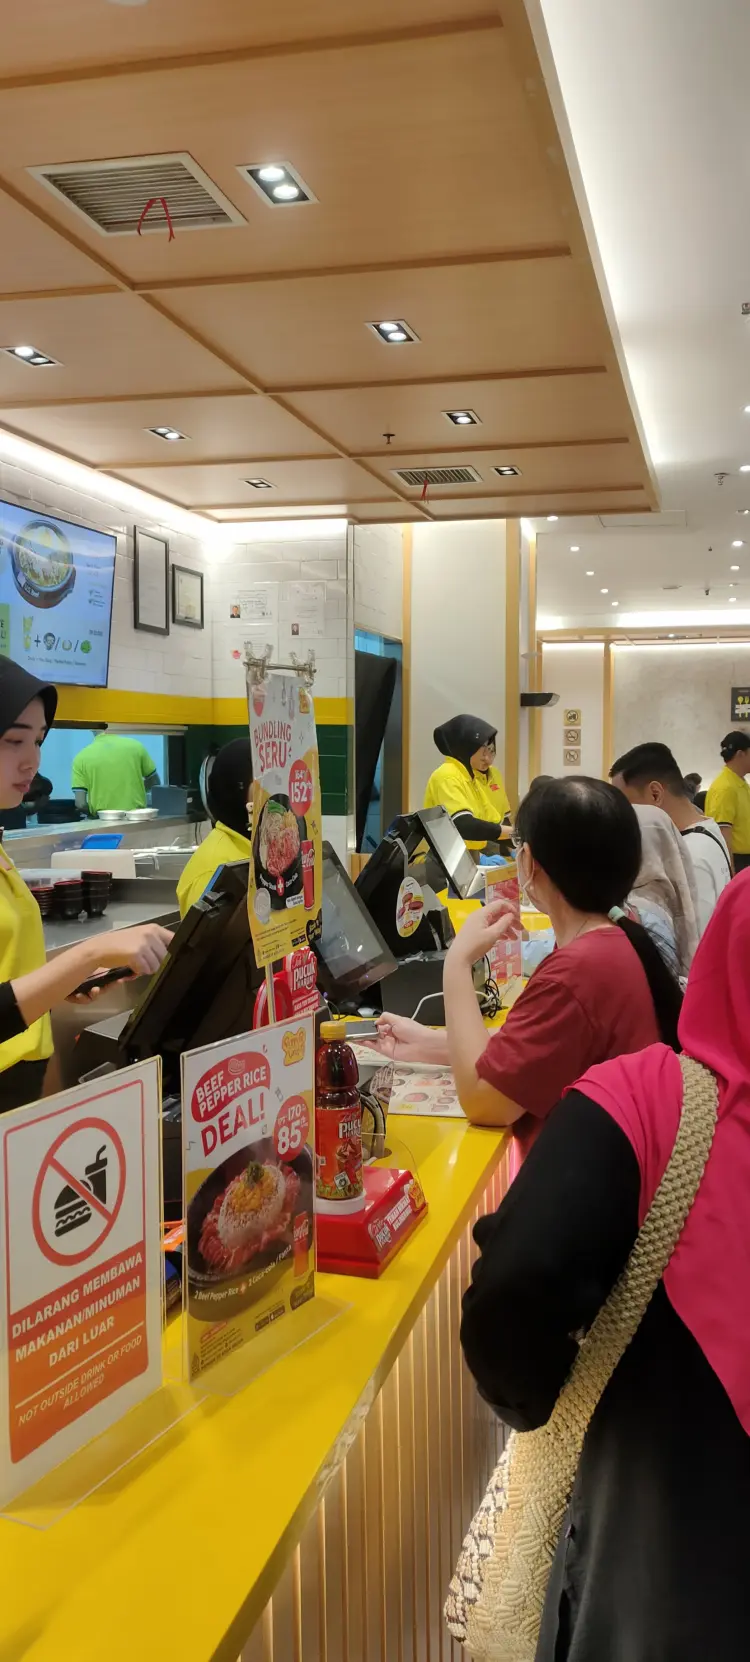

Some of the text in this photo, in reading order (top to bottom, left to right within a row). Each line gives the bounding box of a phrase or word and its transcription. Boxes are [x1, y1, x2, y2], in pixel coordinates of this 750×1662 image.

[254, 720, 291, 748] BUNDLING
[258, 742, 287, 772] SERU
[196, 1070, 224, 1103] BEEF
[199, 1065, 267, 1118] PEPPER RICE
[201, 1092, 265, 1157] DEAL!
[278, 1121, 301, 1155] 85
[12, 1252, 143, 1339] DILARANG MEMBAWA
[198, 1290, 210, 1301] Beef
[210, 1289, 228, 1301] Pepper
[228, 1287, 239, 1297] Rice
[15, 1276, 140, 1362] MAKANAN/MINUMAN
[49, 1316, 115, 1368] DARI LUAR
[18, 1335, 142, 1426] NOT OUTSIDE DRINK OR FOOD
[63, 1373, 105, 1410] ALLOWED
